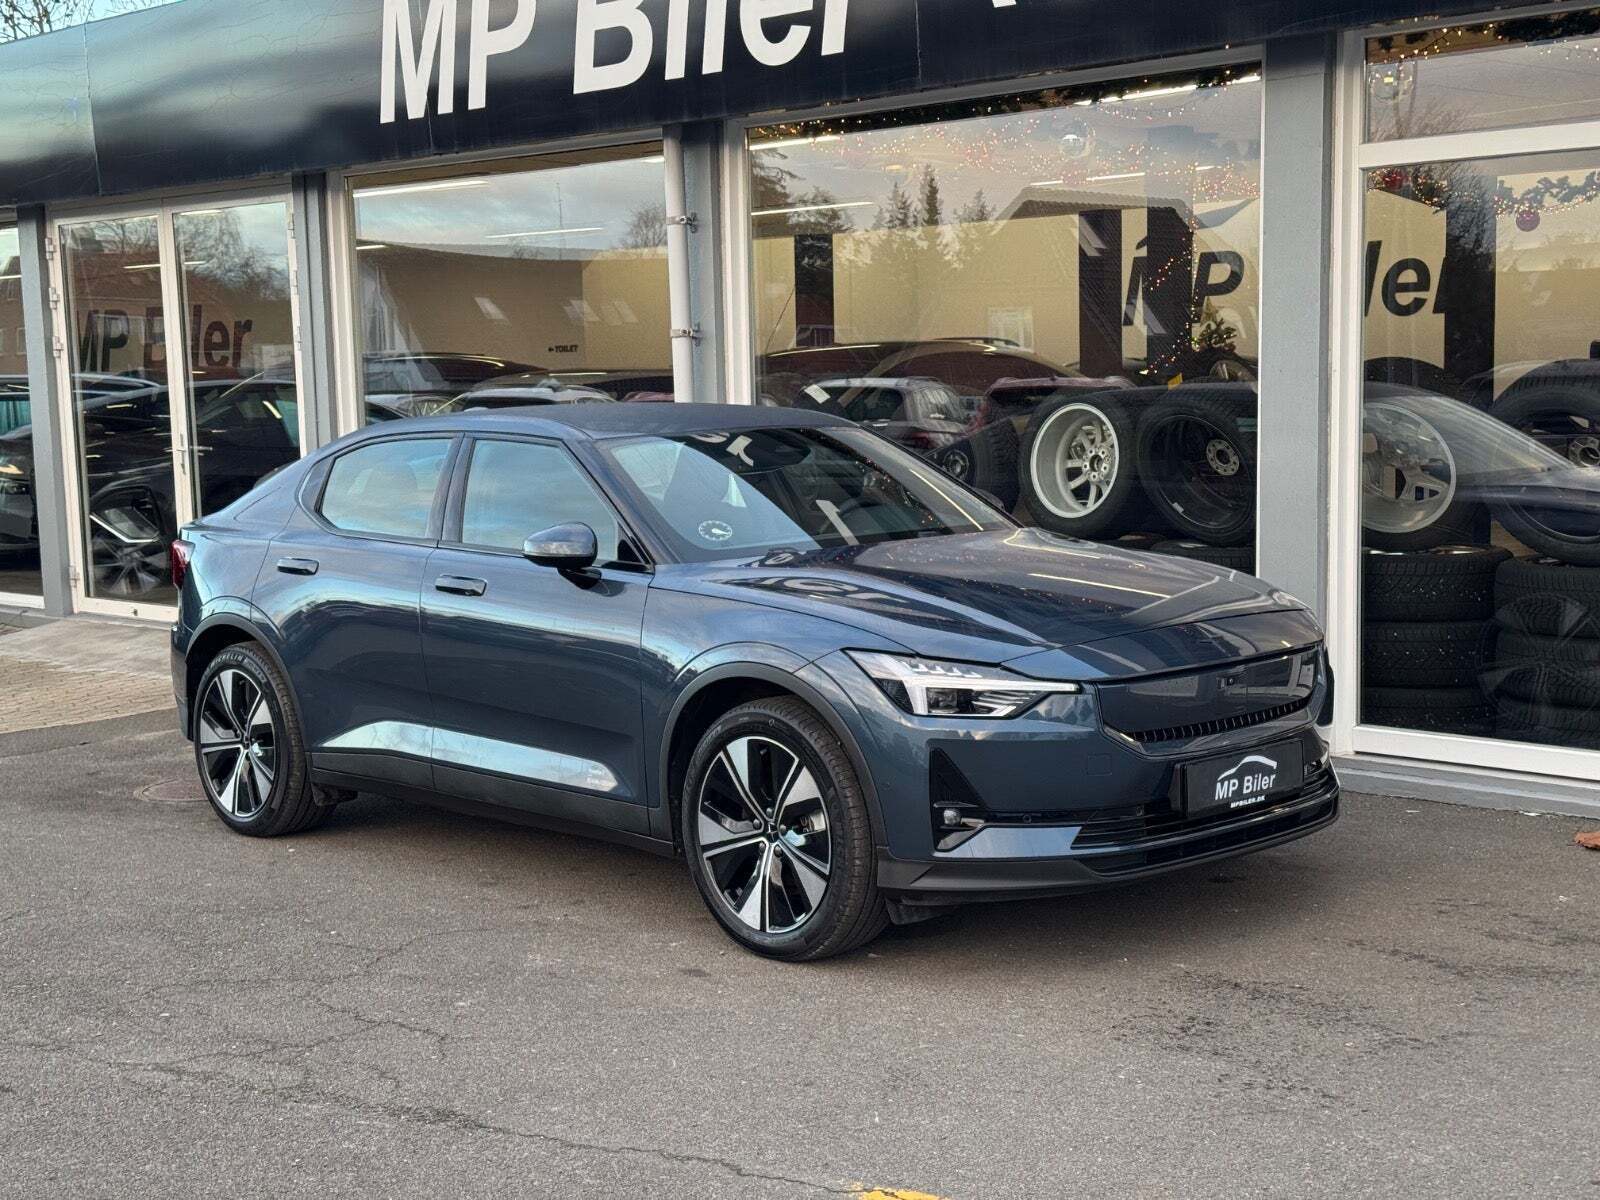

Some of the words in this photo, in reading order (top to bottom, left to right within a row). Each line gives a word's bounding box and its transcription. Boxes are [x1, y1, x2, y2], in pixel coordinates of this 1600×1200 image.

[380, 0, 537, 124] MP
[143, 304, 253, 370] Bler
[1215, 778, 1239, 801] MP
[1243, 773, 1276, 794] Biler
